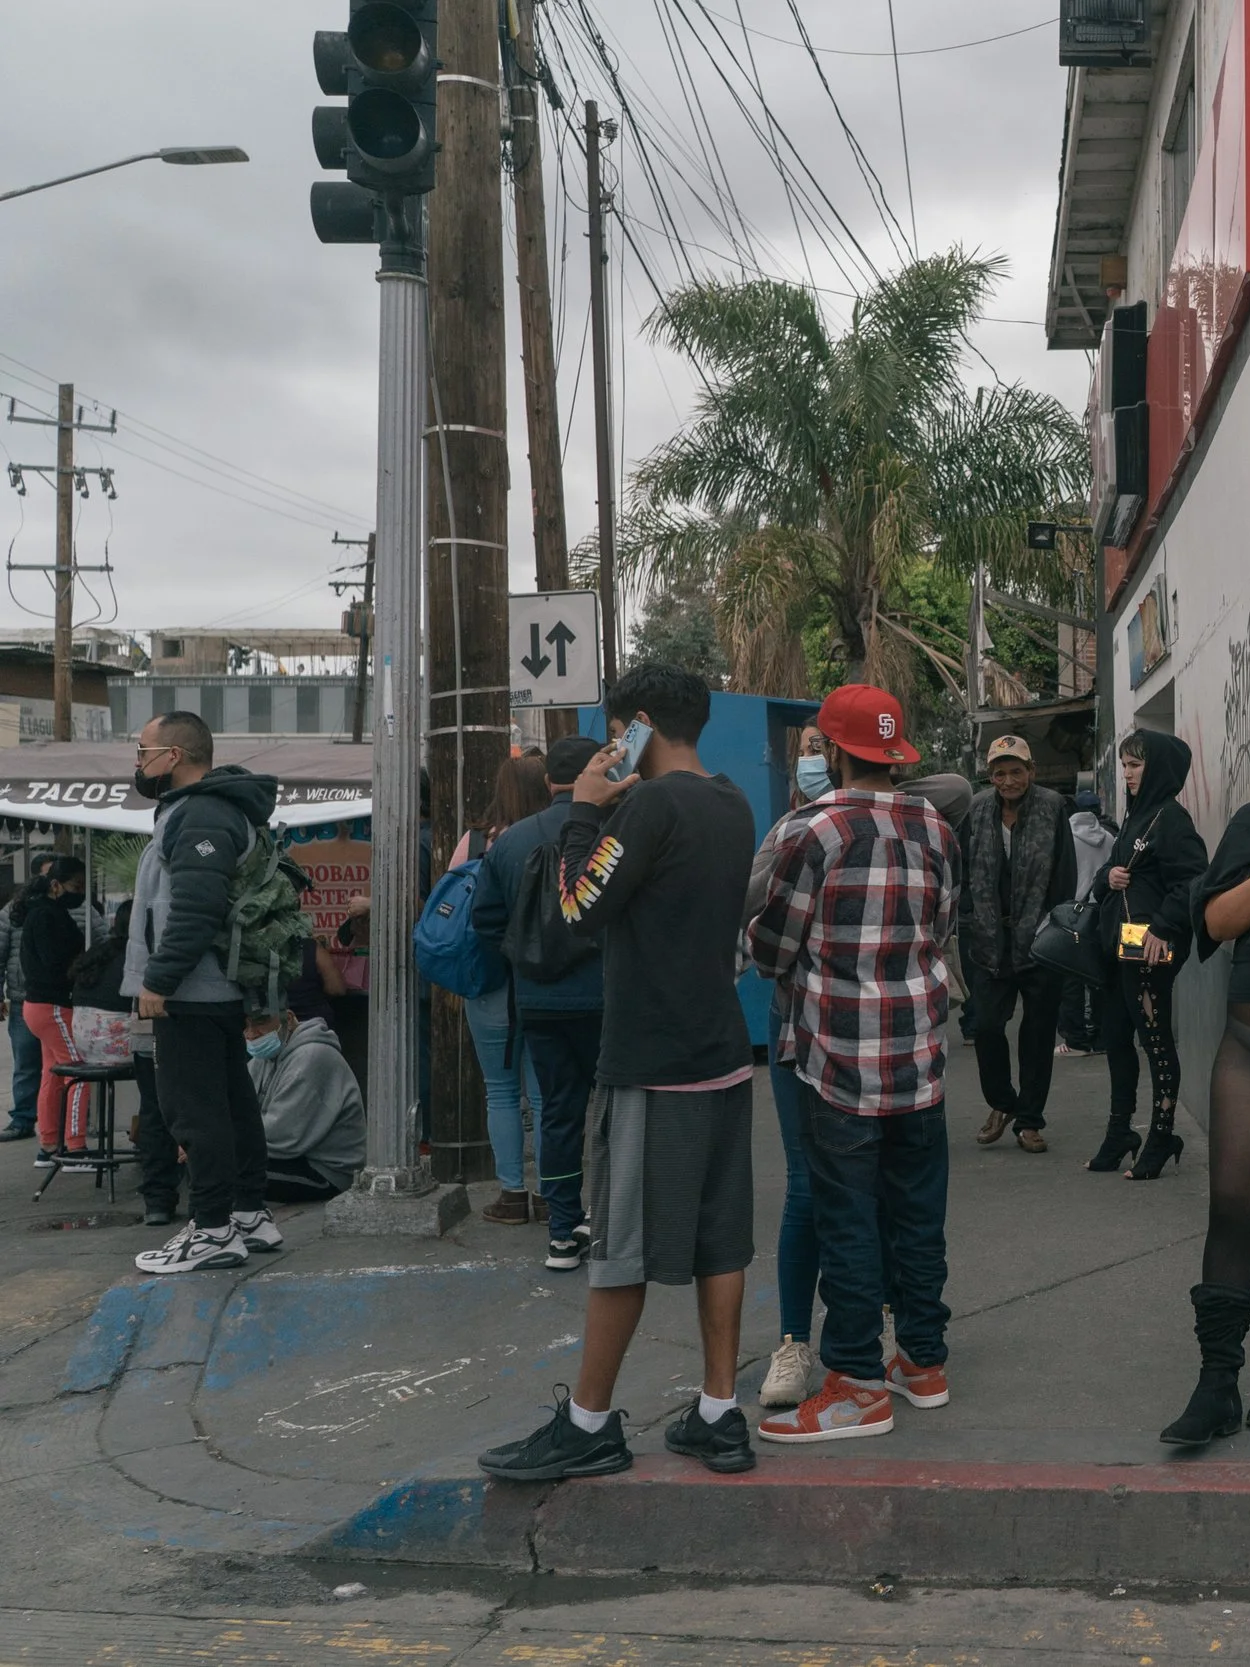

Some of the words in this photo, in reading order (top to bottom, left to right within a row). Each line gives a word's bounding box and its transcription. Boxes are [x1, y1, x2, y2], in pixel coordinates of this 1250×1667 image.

[879, 713, 895, 740] SD
[26, 782, 131, 803] TACOS
[306, 787, 363, 801] WELCOME
[586, 835, 624, 886] ONE
[575, 875, 602, 910] IN
